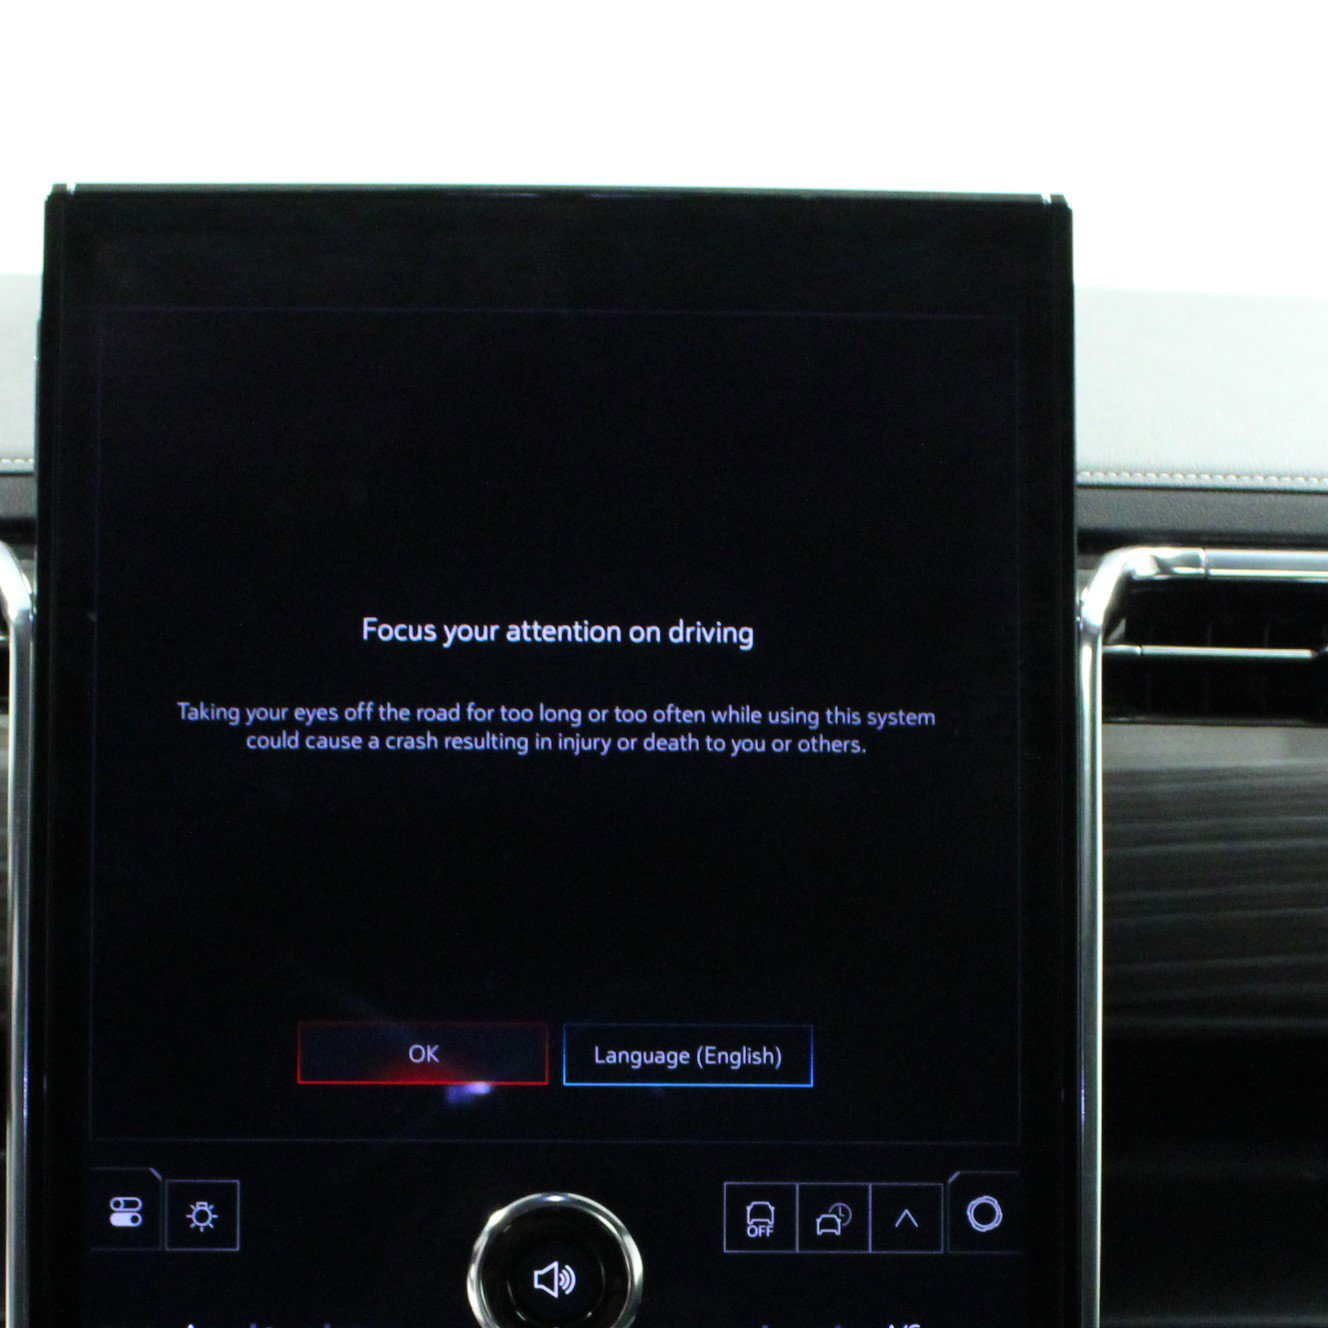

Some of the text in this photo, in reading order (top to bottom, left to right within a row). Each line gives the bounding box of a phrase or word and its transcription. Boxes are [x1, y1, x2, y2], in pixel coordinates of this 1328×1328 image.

[362, 616, 754, 651] Focus your attention on driving
[177, 701, 936, 731] Taking your eyes off the road for too long or too often while using this system
[246, 730, 867, 758] could cause a crash resulting in injury or death to you or others.
[408, 1044, 440, 1063] OK
[594, 1045, 782, 1069] Language (English)
[746, 1224, 775, 1239] OFF
